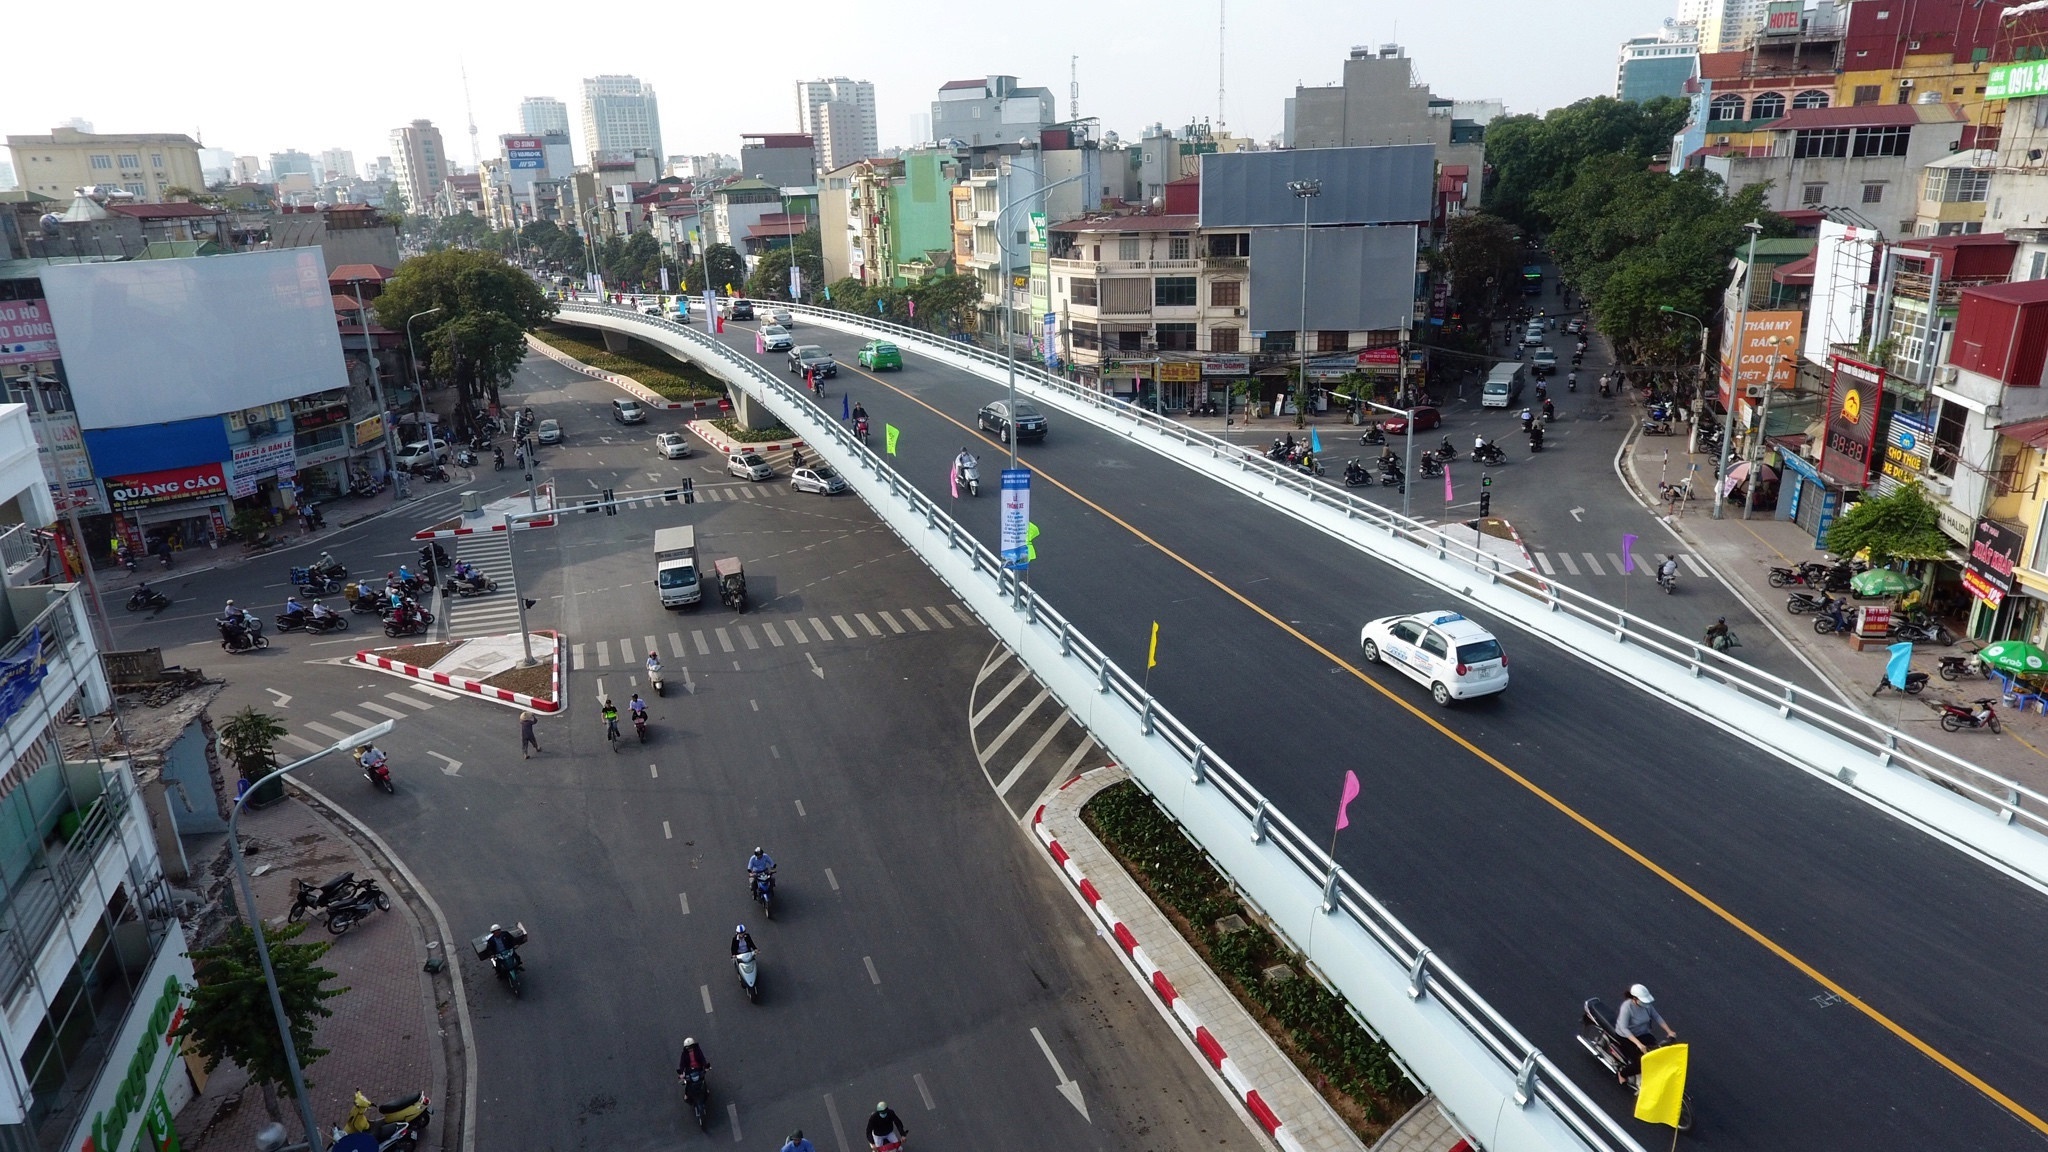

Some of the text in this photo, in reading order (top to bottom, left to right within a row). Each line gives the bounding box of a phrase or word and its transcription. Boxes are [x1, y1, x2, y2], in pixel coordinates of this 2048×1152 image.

[1770, 11, 1799, 29] HOTEL
[2008, 65, 2033, 94] 0914
[19, 305, 39, 320] HỘ
[13, 321, 53, 338] ĐỘNG
[1741, 354, 1763, 364] CAO
[1888, 446, 1902, 461] CHO
[1883, 461, 1892, 474] XE
[113, 482, 179, 502] QUẢNG
[184, 475, 220, 490] CÁO
[1947, 515, 1969, 536] HALIDA
[2000, 656, 2022, 667] Grab
